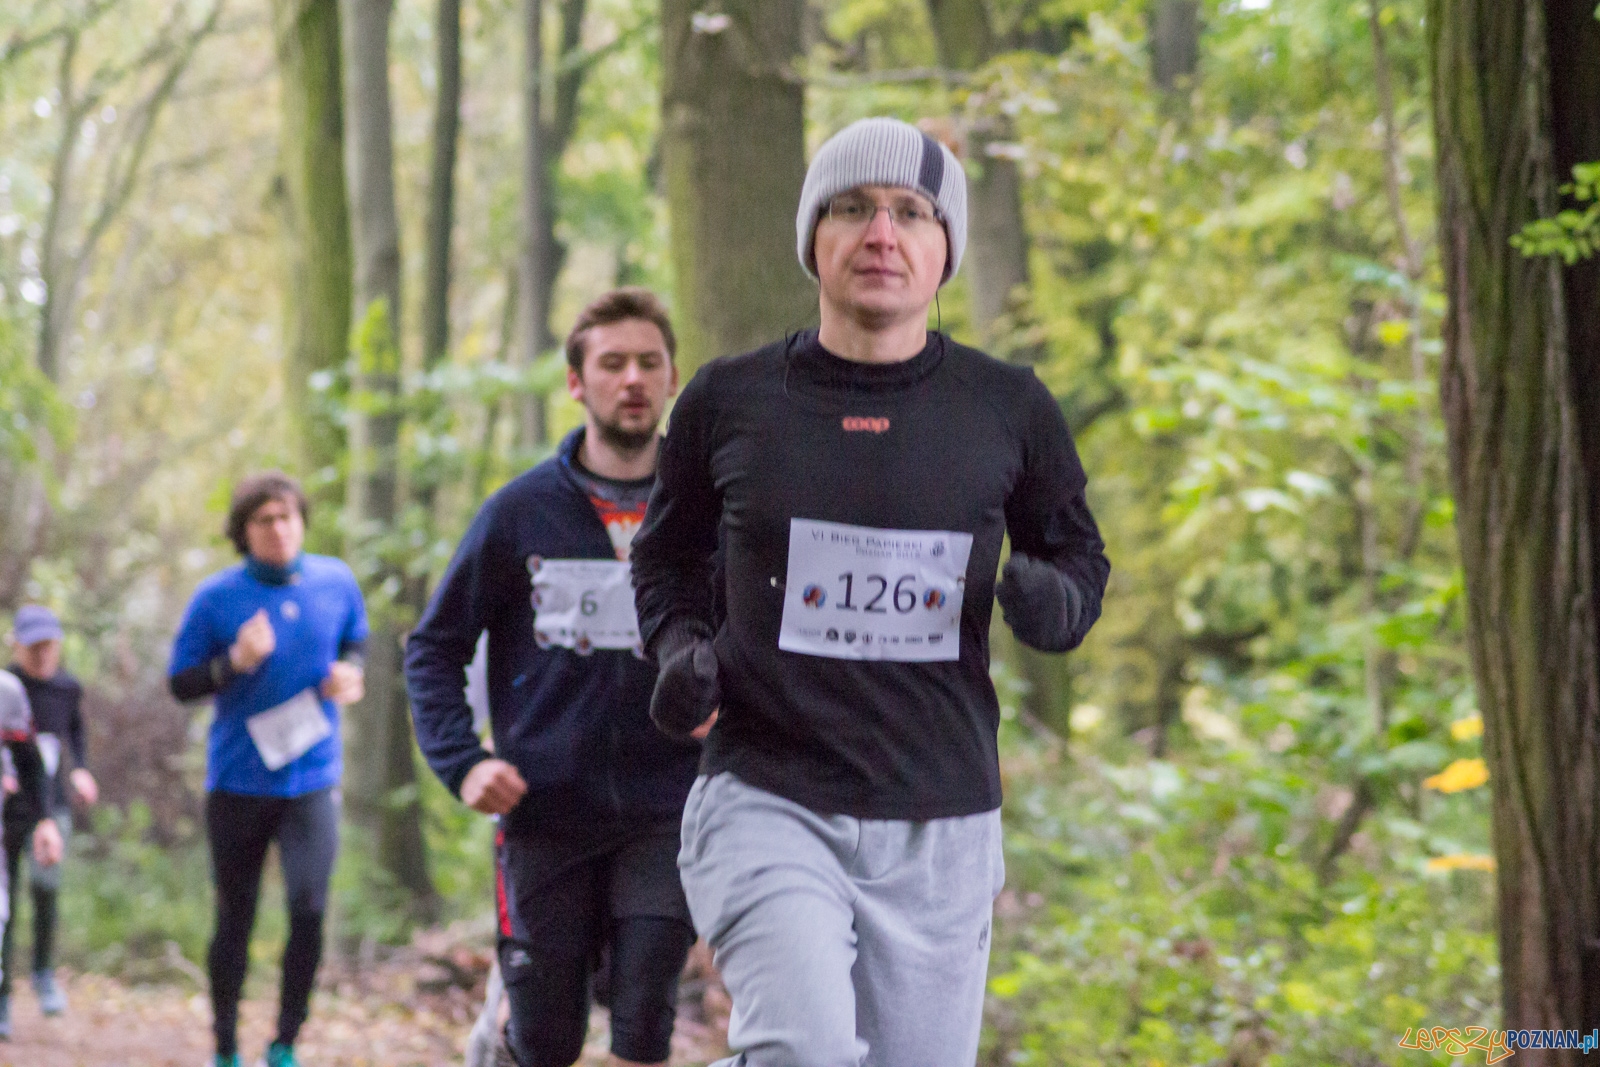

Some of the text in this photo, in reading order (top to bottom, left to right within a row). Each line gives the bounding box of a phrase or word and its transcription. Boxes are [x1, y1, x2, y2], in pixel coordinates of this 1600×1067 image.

[842, 416, 890, 434] coop
[581, 589, 598, 616] 6
[836, 570, 917, 614] 126
